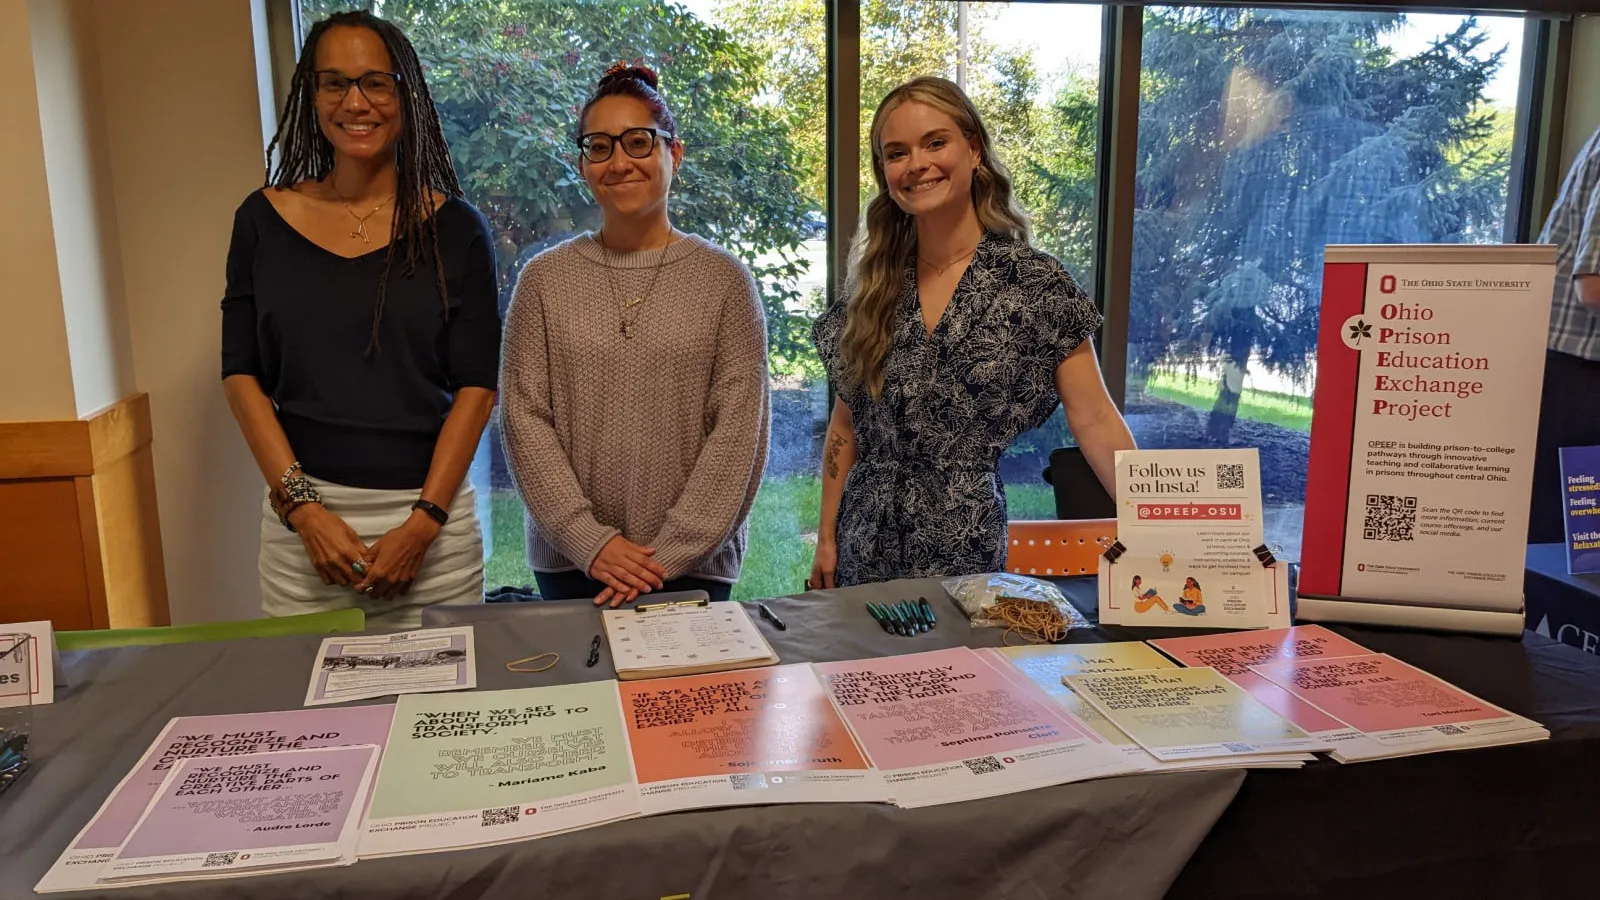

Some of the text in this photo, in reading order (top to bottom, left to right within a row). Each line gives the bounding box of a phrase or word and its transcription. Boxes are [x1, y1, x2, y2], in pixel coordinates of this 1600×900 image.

[1381, 304, 1433, 320] Ohio
[1378, 327, 1450, 345] Prison
[1376, 352, 1489, 370] Education
[1375, 375, 1483, 398] Exchange
[1372, 400, 1452, 421] Project
[1368, 440, 1397, 448] OPEEP
[1408, 443, 1440, 451] building
[1444, 444, 1515, 454] prison-to-college
[1368, 450, 1487, 462] pathways through innovative
[1129, 463, 1206, 477] Follow us
[1367, 459, 1400, 468] teaching
[1421, 462, 1473, 470] collaborative
[1476, 465, 1510, 473] learning
[1408, 470, 1453, 479] throughout
[1568, 475, 1594, 486] Feeling
[1129, 480, 1200, 493] on Insta!
[1570, 496, 1596, 506] Feeling
[1139, 507, 1237, 517] @OPEEP_OSU
[1572, 532, 1590, 541] Visit
[870, 676, 922, 686] ABILITY
[905, 673, 976, 688] RESPOND
[1084, 679, 1148, 688] TEACHING
[1088, 674, 1157, 684] CELEBRATE
[1299, 679, 1366, 690] SOMEBODY
[690, 682, 746, 693] LAUGH
[876, 684, 951, 698] THEY ARE
[1094, 686, 1201, 698] TRANSGRESSIONS
[633, 696, 671, 704] SING
[698, 687, 746, 697] LITTLE
[666, 695, 713, 705] FIGHT
[1100, 689, 1228, 701] MOVEMENT AGAINST
[1138, 696, 1191, 704] BEYOND
[634, 697, 740, 715] GOOD FIGHT
[414, 717, 480, 726] ABOUT
[488, 711, 556, 721] TRYING
[416, 711, 480, 719] "WHEN
[636, 712, 695, 724] MAKES
[413, 719, 528, 732] TRANSFORM
[169, 732, 340, 750] RECOGNIZE AND
[222, 730, 277, 740] MUST
[939, 733, 994, 748] Septima
[164, 745, 258, 757] NURTURE
[188, 768, 280, 779] RECOGNIZE
[498, 764, 606, 788] Mariame Kaba
[179, 780, 258, 790] CREATIVE
[263, 776, 312, 785] PARTS
[184, 775, 258, 785] NURTURE
[429, 814, 478, 823] EDUCATION
